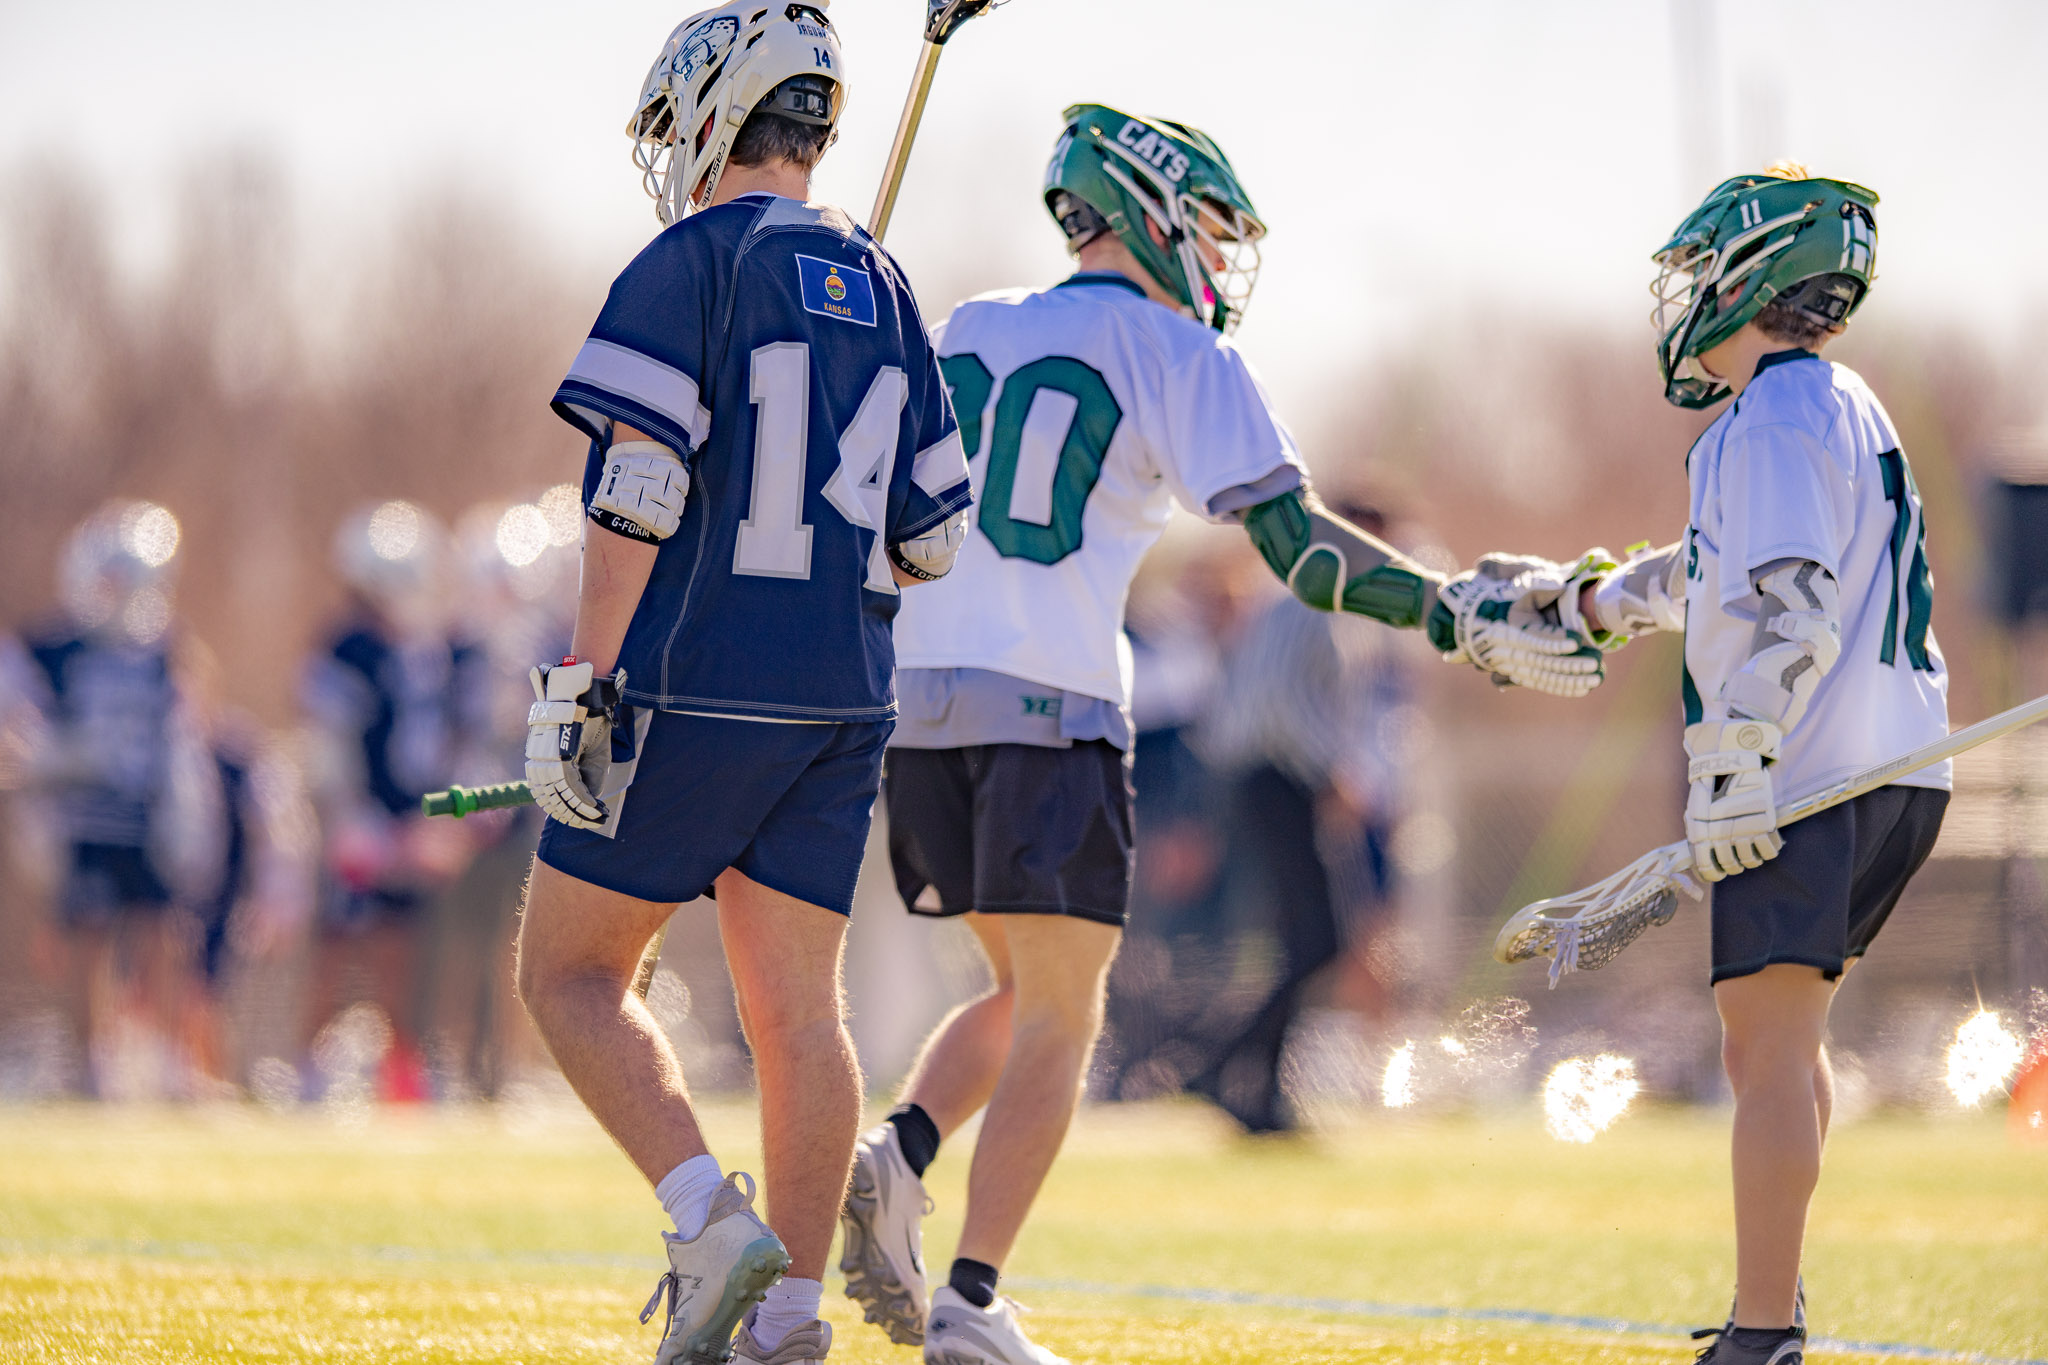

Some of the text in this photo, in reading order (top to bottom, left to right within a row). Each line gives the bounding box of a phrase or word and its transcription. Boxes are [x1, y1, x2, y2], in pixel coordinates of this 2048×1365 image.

[814, 47, 831, 69] 14
[1117, 119, 1190, 182] CATS
[701, 141, 727, 207] cascade
[1740, 199, 1763, 229] 11
[824, 302, 852, 316] KANSAS
[732, 341, 909, 595] 14
[611, 516, 650, 538] G-FORM
[560, 725, 572, 751] STX
